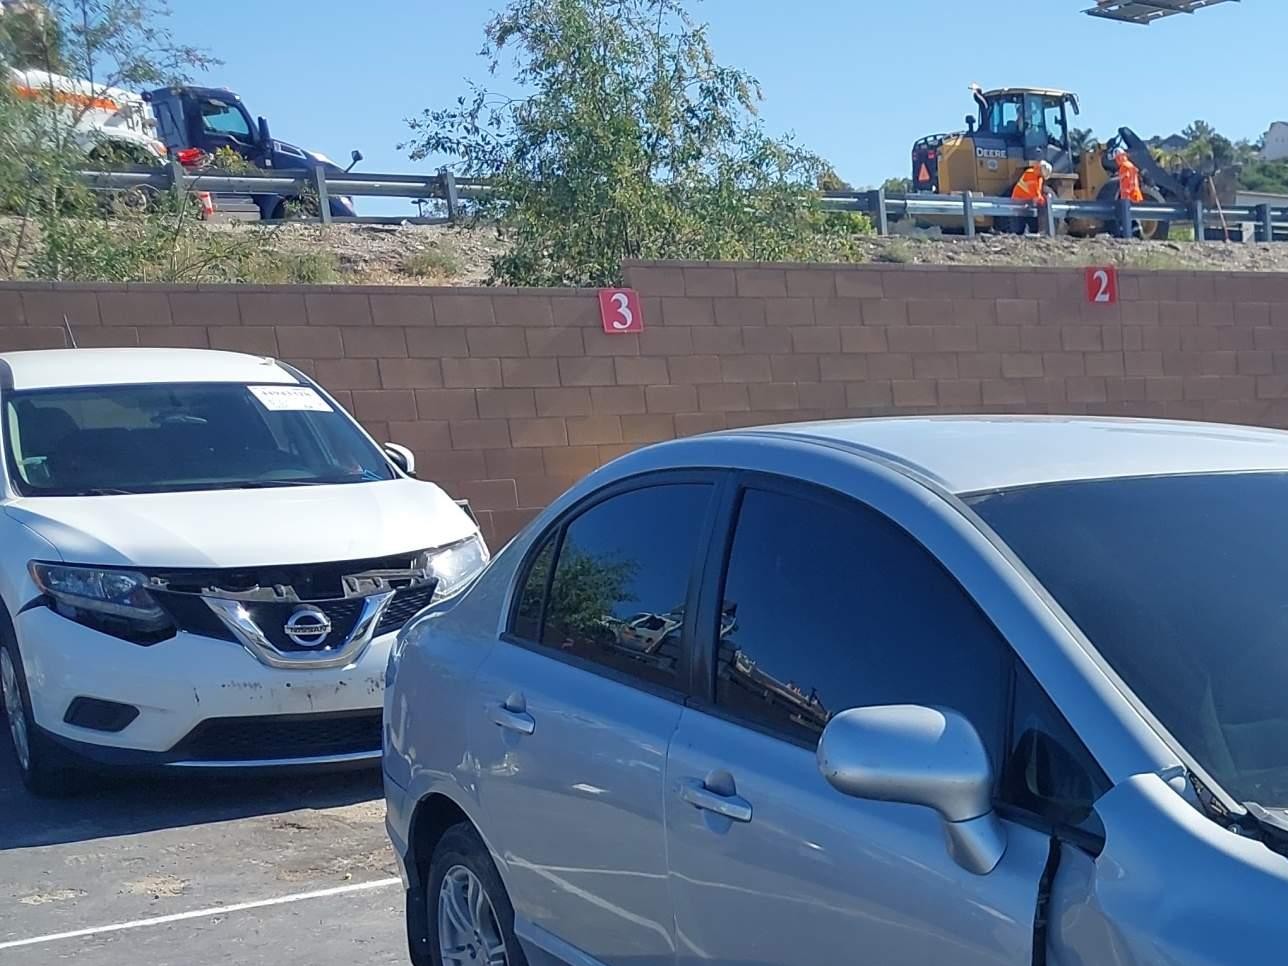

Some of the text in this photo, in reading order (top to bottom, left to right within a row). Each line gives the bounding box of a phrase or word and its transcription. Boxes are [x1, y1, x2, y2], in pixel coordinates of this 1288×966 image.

[976, 147, 1007, 159] DEERE
[1093, 270, 1110, 302] 2
[610, 292, 632, 329] 3
